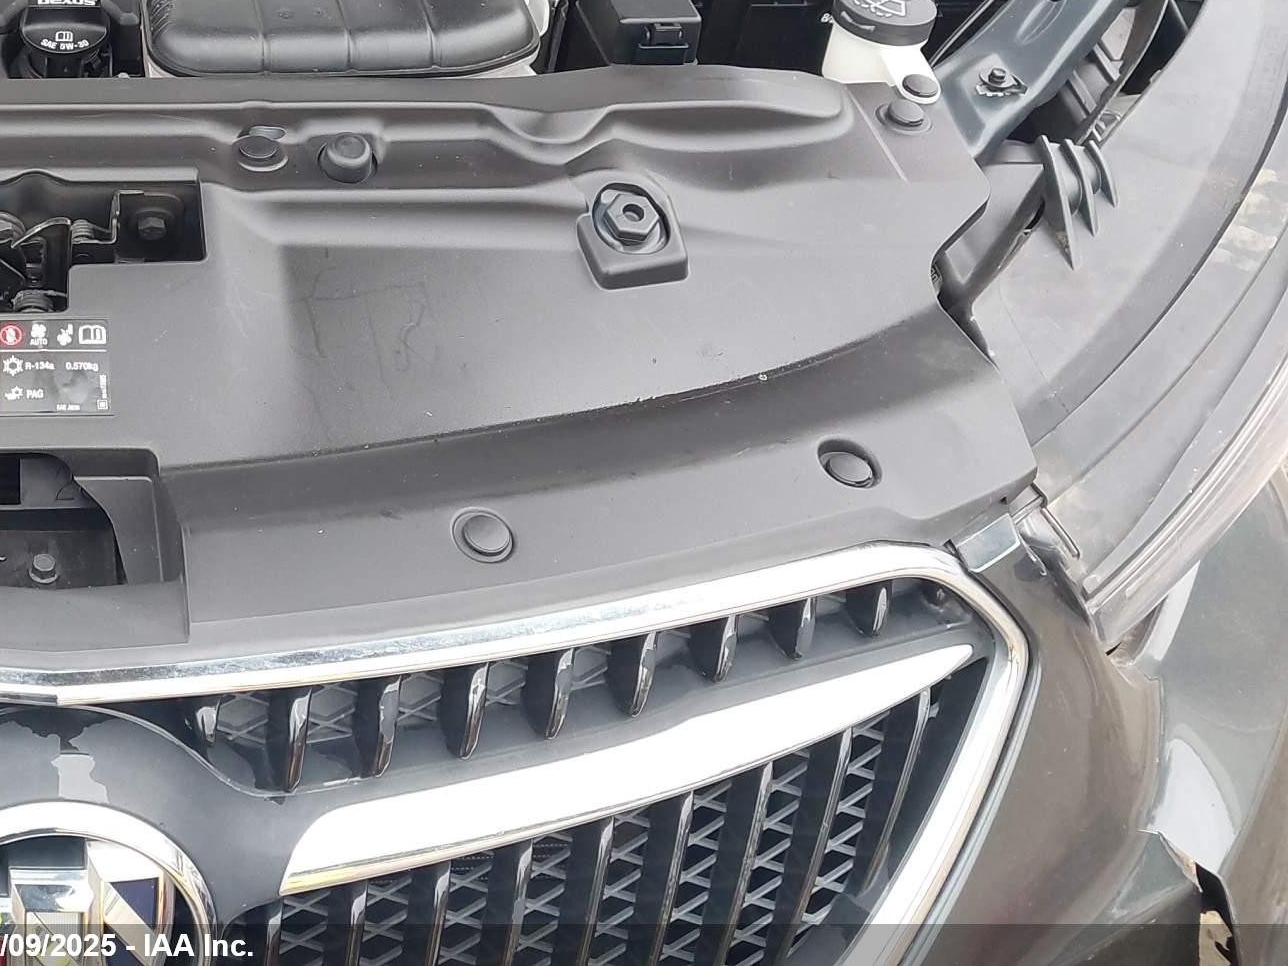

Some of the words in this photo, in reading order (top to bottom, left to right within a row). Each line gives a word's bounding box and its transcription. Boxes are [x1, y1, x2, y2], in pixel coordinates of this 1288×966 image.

[40, 38, 58, 50] SAE
[30, 338, 48, 346] AUTO
[25, 361, 55, 371] R-134a
[65, 361, 99, 372] 0.570kg
[26, 389, 44, 399] PAG
